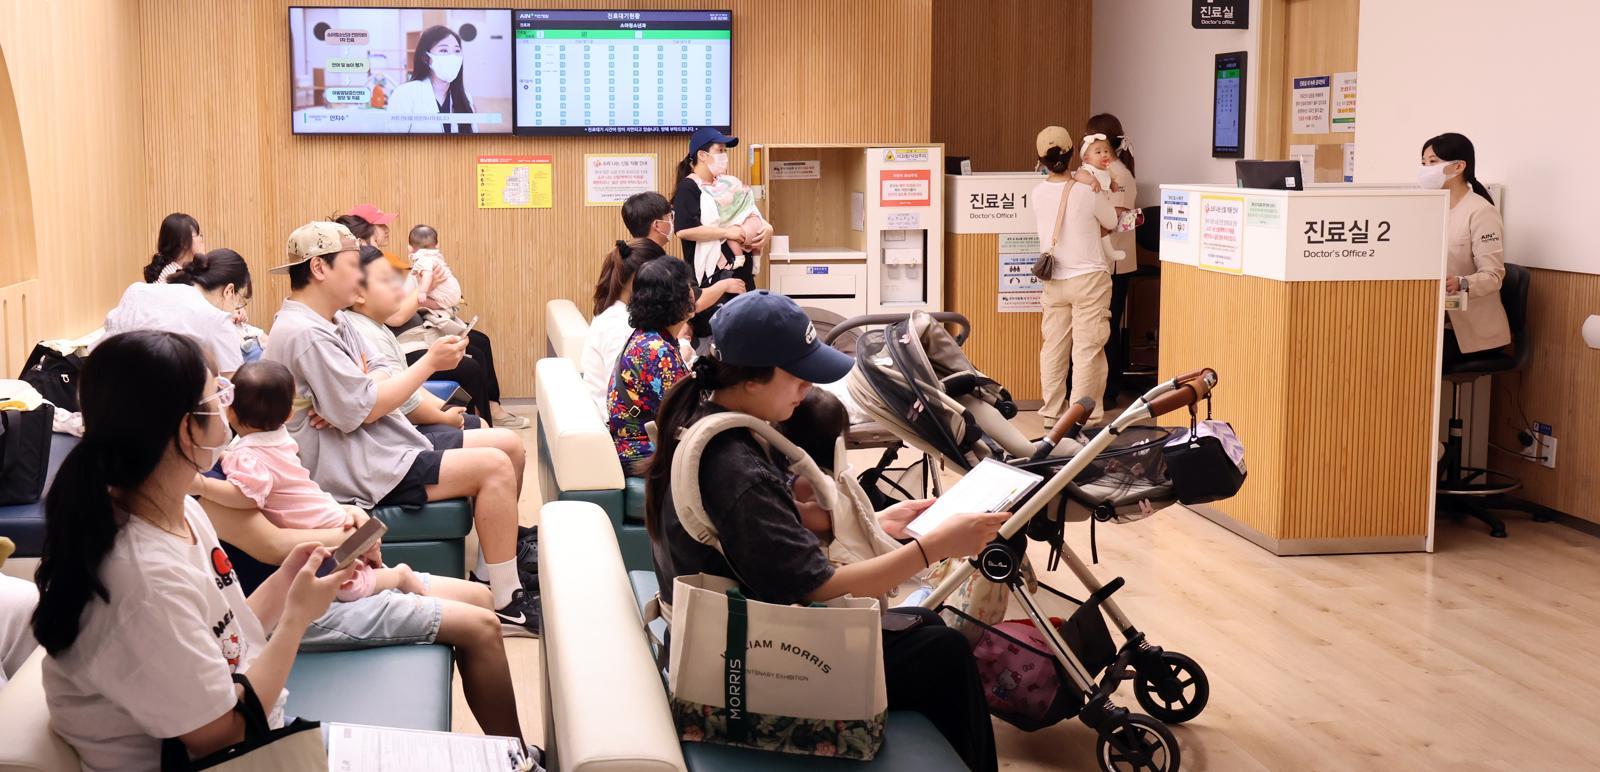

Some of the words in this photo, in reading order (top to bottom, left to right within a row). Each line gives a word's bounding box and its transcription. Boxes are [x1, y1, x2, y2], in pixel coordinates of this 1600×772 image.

[1200, 6, 1234, 18] 진료실
[970, 192, 1014, 209] 진료실
[1021, 193, 1027, 208] 1
[1304, 219, 1369, 244] 진료실
[1377, 220, 1391, 242] 2
[1303, 249, 1340, 258] Doctor's
[1341, 249, 1367, 258] Office
[1369, 249, 1375, 257] 2
[780, 642, 832, 674] MORRIS
[775, 672, 809, 681] EXHIBITION
[729, 659, 741, 720] MORRIS
